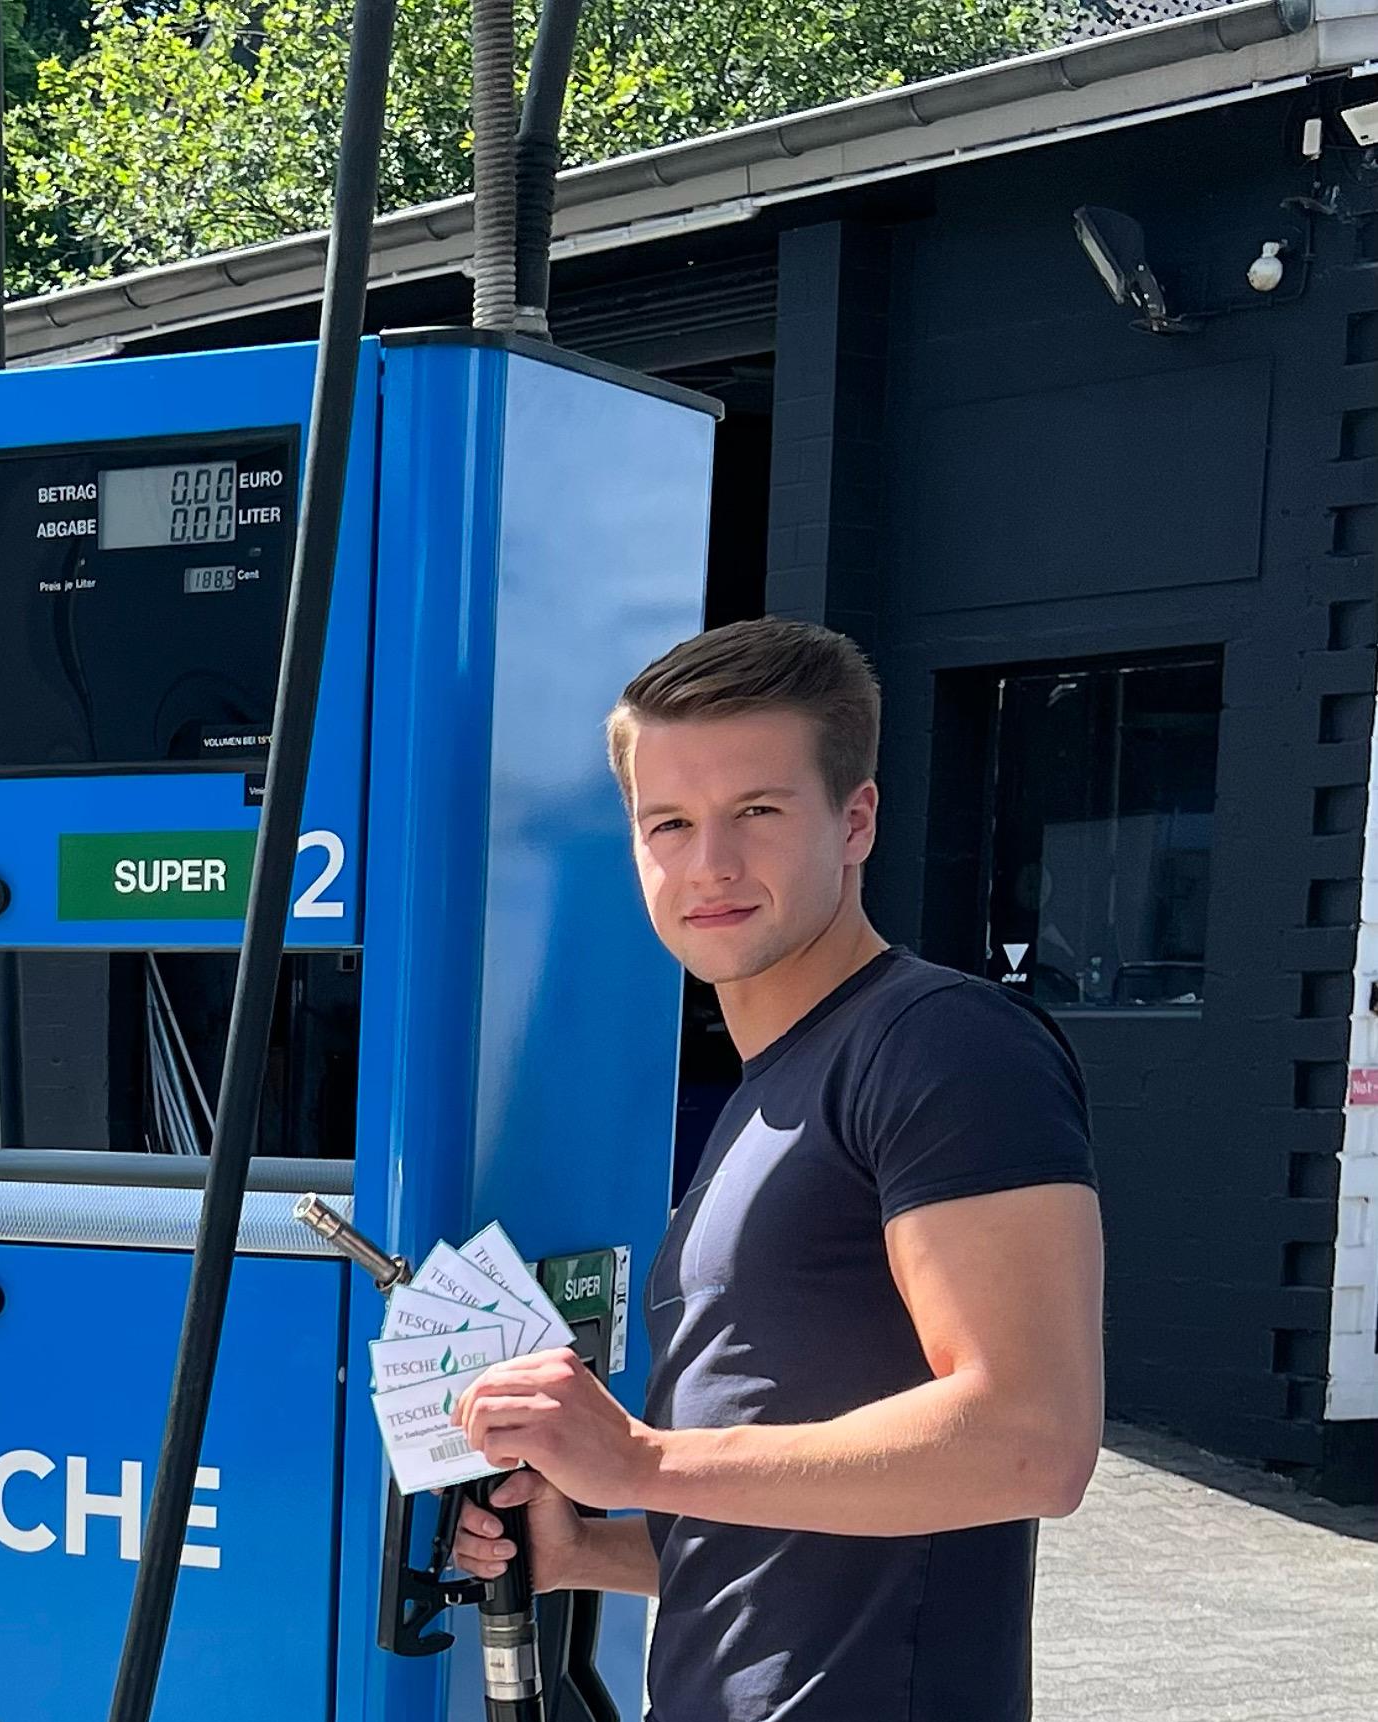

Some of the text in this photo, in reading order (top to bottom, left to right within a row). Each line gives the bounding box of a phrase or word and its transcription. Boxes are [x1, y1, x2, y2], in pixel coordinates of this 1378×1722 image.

[239, 470, 283, 489] EURO
[37, 484, 97, 503] BETRAG
[238, 507, 281, 525] LITER
[36, 519, 97, 538] ABGABE
[237, 569, 260, 580] Cent
[39, 577, 97, 592] Preis je Liter
[203, 737, 242, 747] VOLUMEN
[113, 859, 227, 892] SUPER
[292, 830, 345, 919] 2
[564, 1275, 601, 1301] SUPER
[382, 1358, 438, 1378] TESCHE
[387, 1402, 442, 1427] TESCHE
